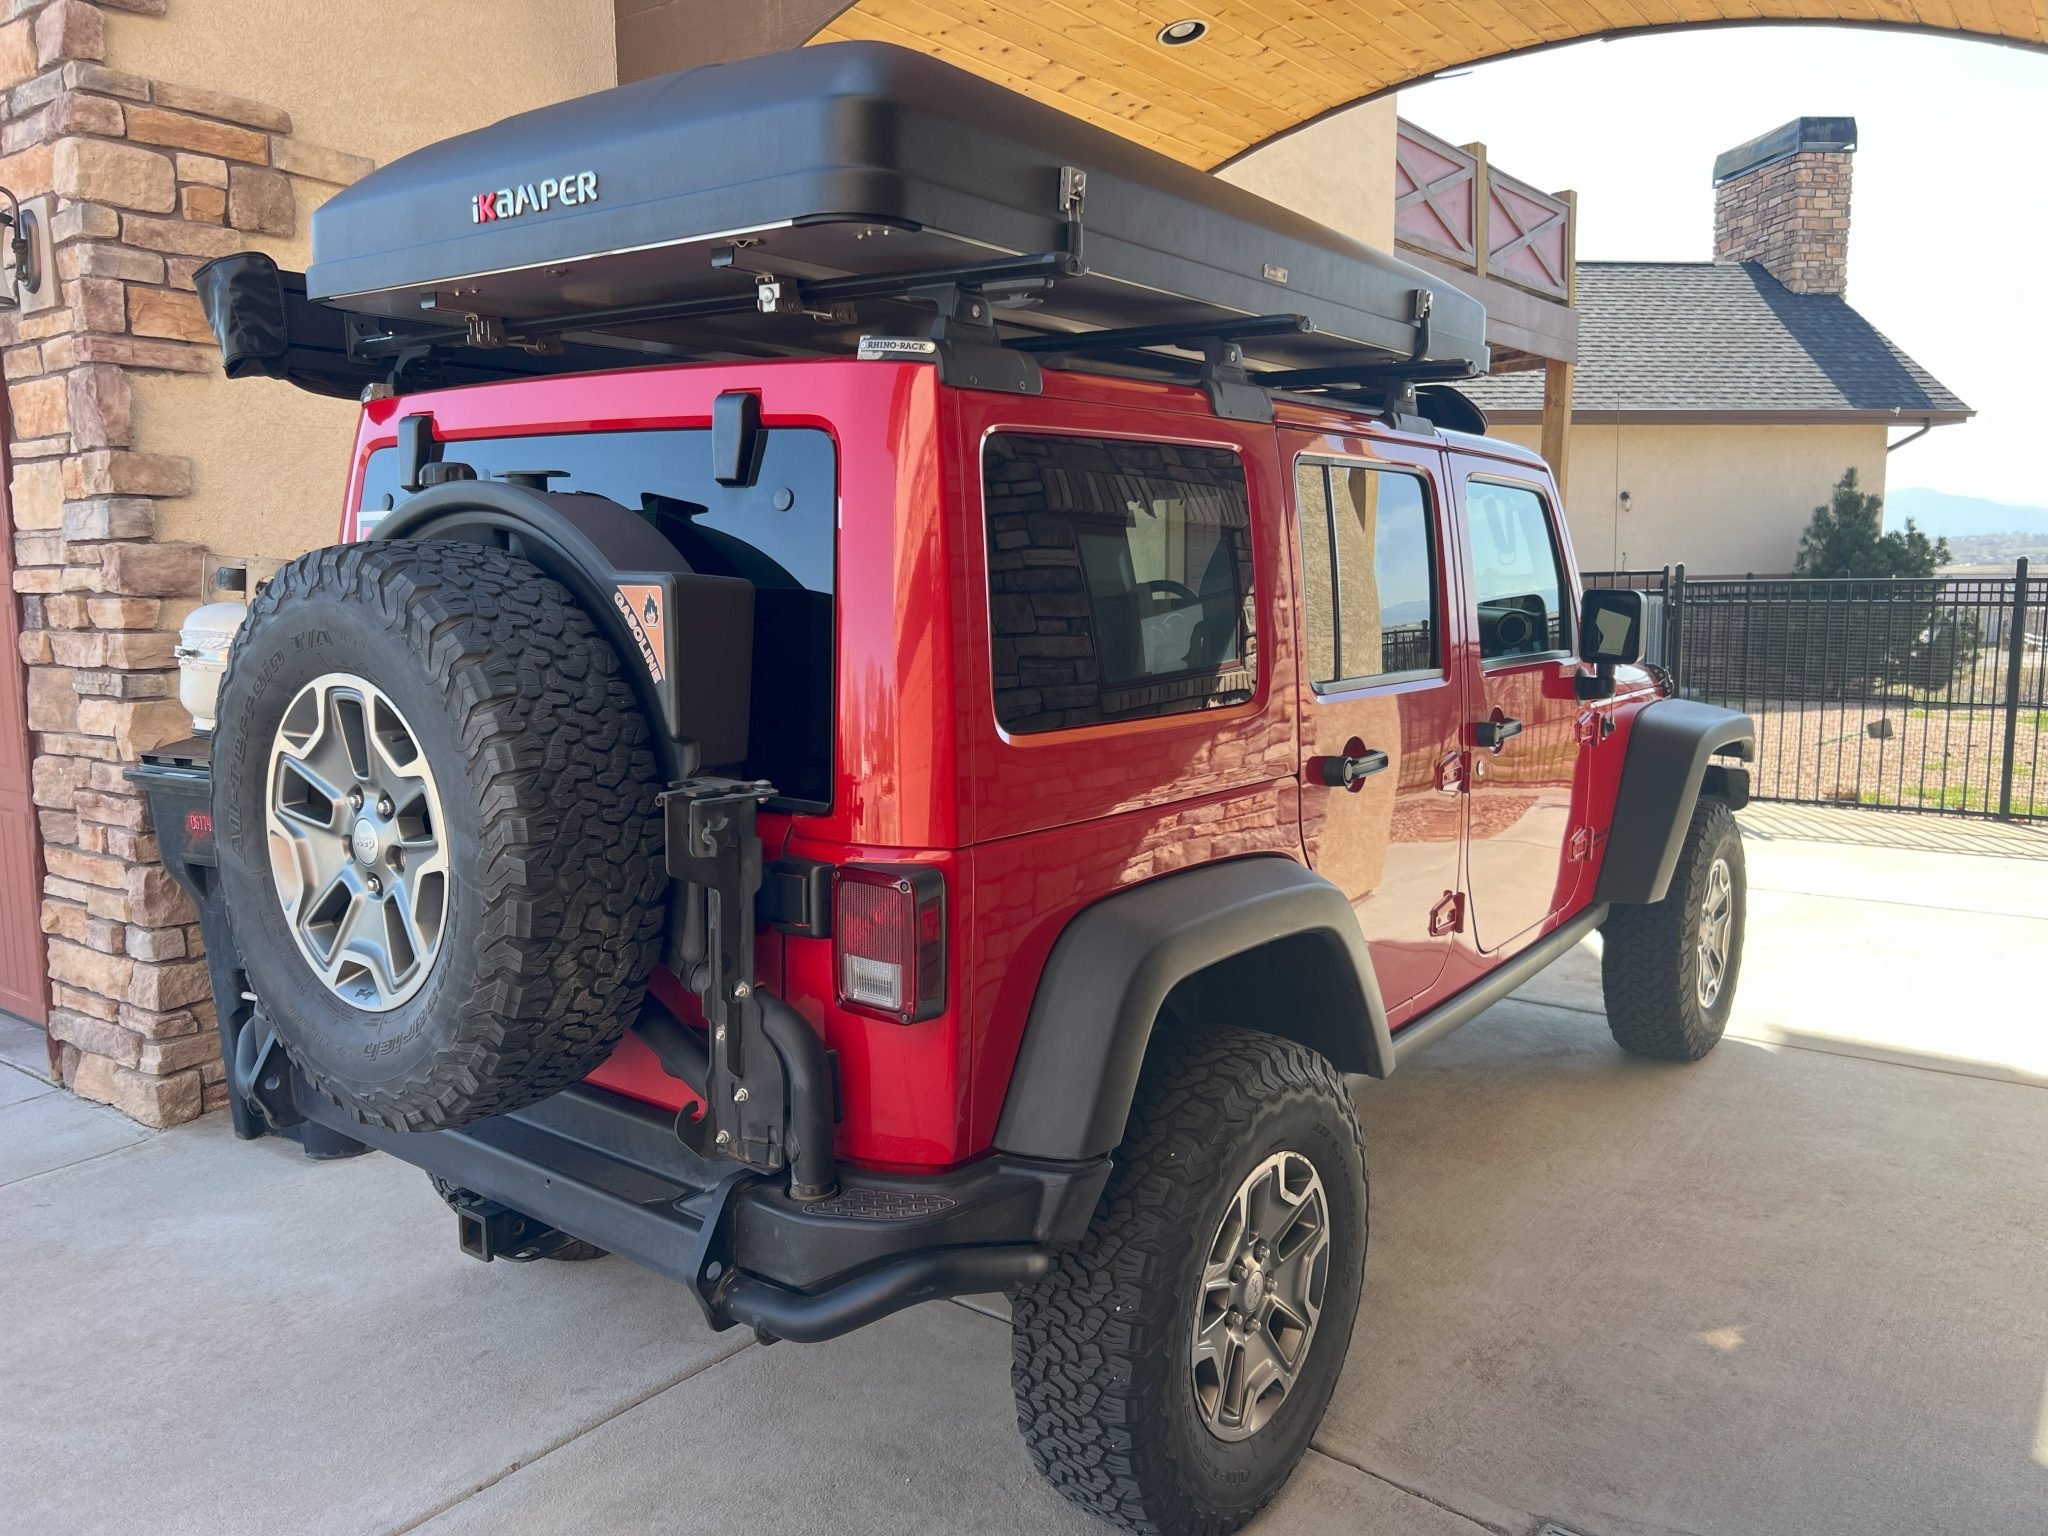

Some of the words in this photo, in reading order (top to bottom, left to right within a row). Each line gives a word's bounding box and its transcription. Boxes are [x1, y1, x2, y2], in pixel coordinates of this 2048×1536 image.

[867, 341, 926, 351] RHINO-RACK
[290, 627, 333, 652] T/A
[614, 591, 662, 685] GASOLINE
